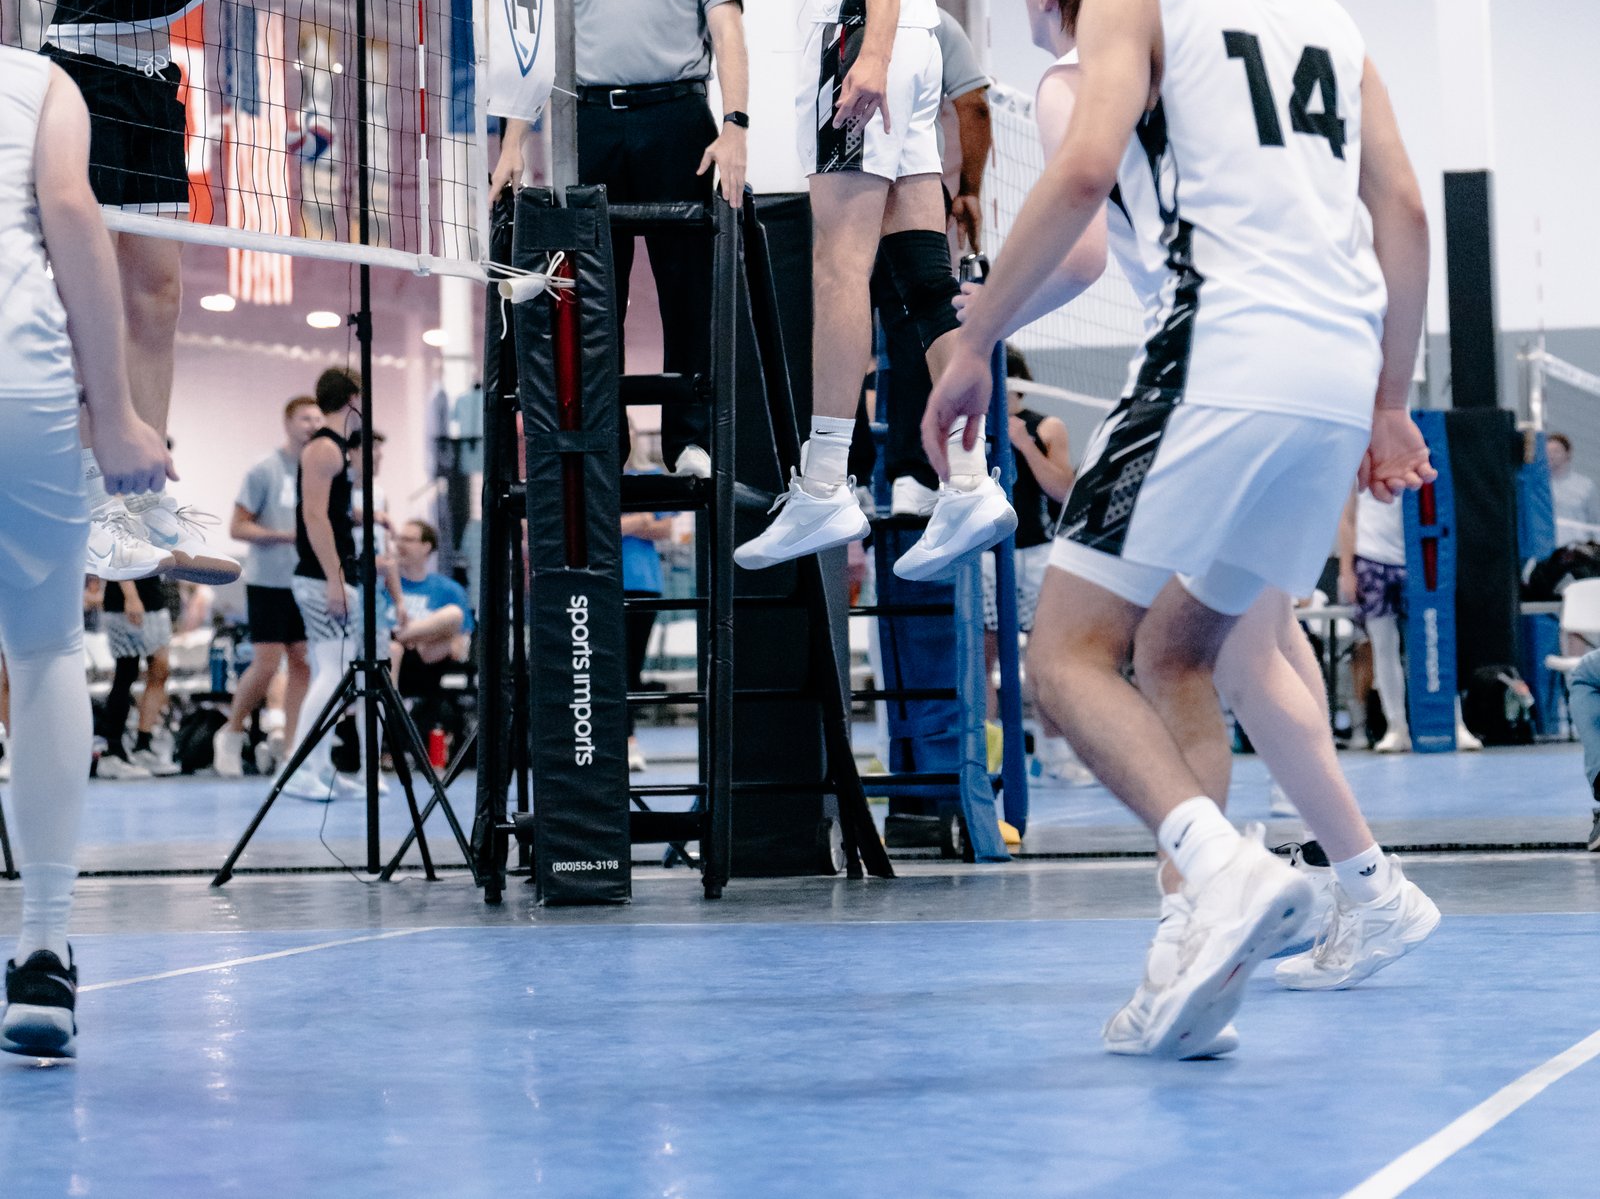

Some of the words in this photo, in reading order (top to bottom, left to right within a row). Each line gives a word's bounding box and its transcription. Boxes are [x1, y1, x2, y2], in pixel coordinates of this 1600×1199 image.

[1222, 28, 1347, 161] 14
[566, 594, 593, 670] sports
[569, 673, 596, 767] imports
[552, 860, 619, 873] (800)556-3198
